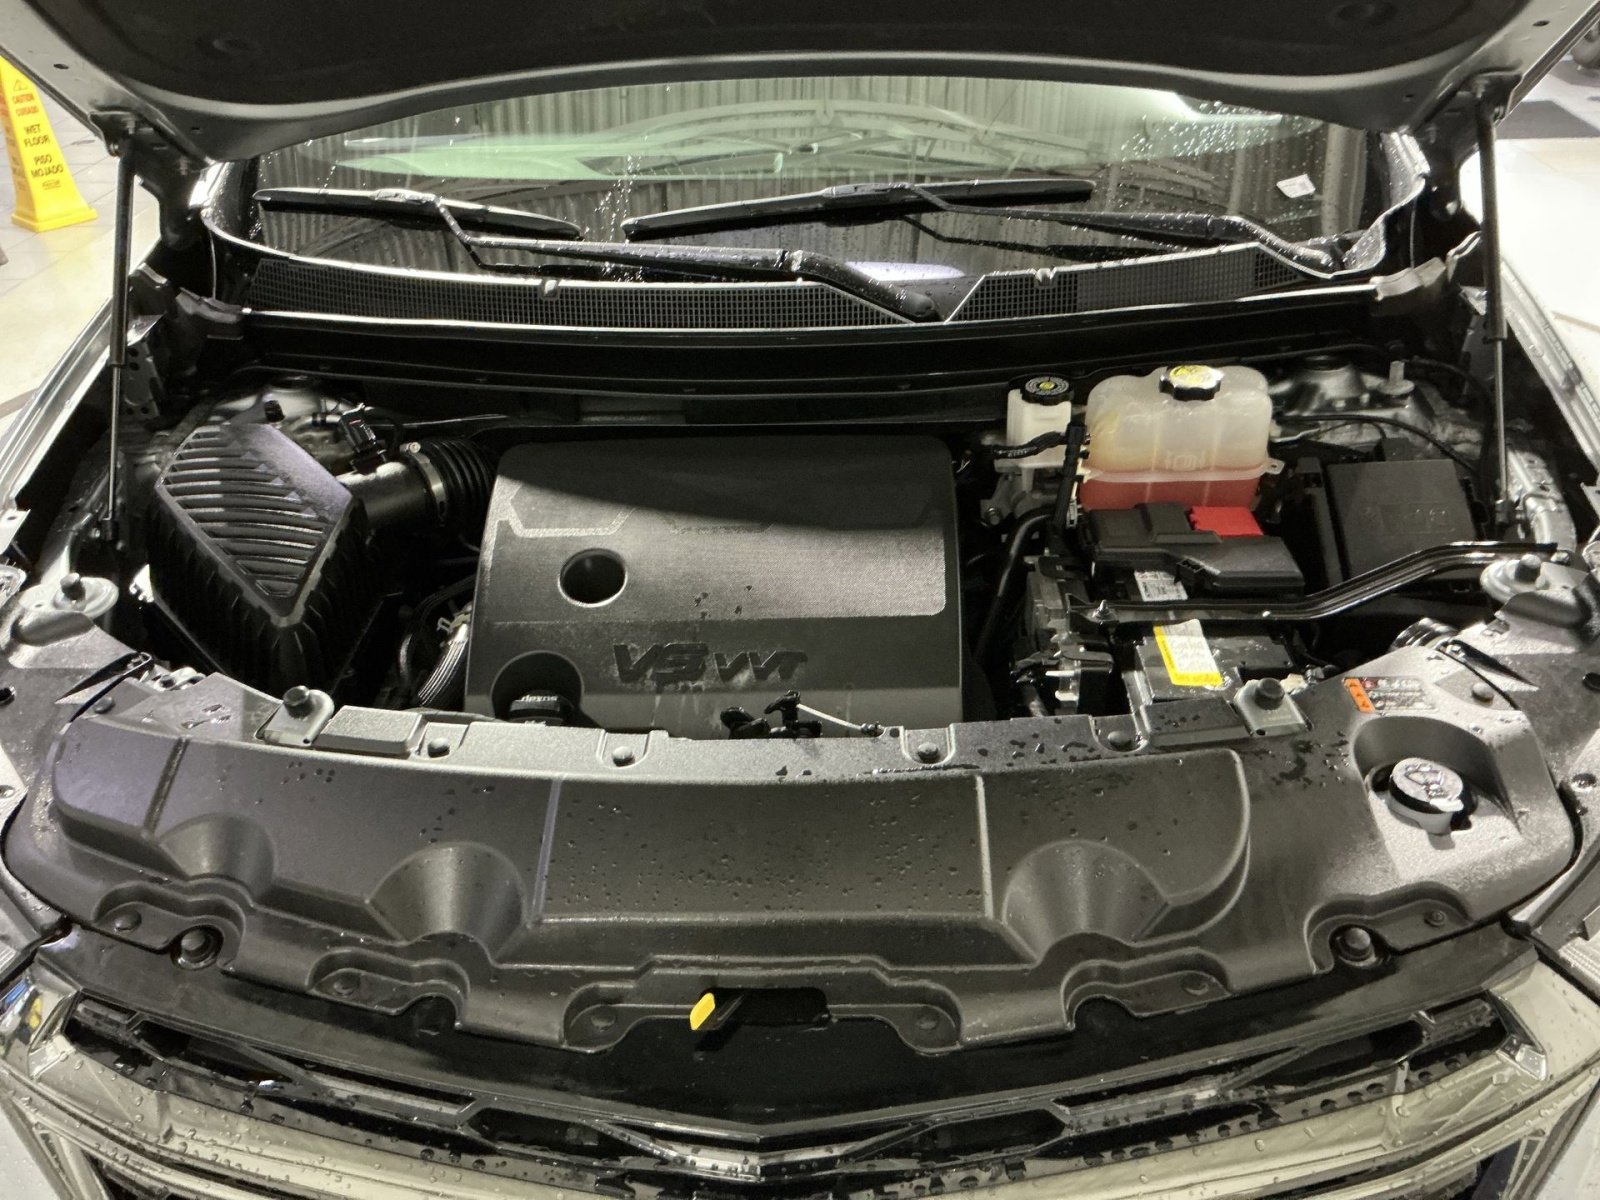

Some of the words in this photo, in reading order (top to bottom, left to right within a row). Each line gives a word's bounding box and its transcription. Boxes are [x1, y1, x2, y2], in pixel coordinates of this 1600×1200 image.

[24, 123, 41, 134] WET
[23, 135, 50, 147] FLOOR
[33, 153, 52, 165] PISO
[31, 165, 63, 177] MOJADO
[712, 650, 809, 682] VVT
